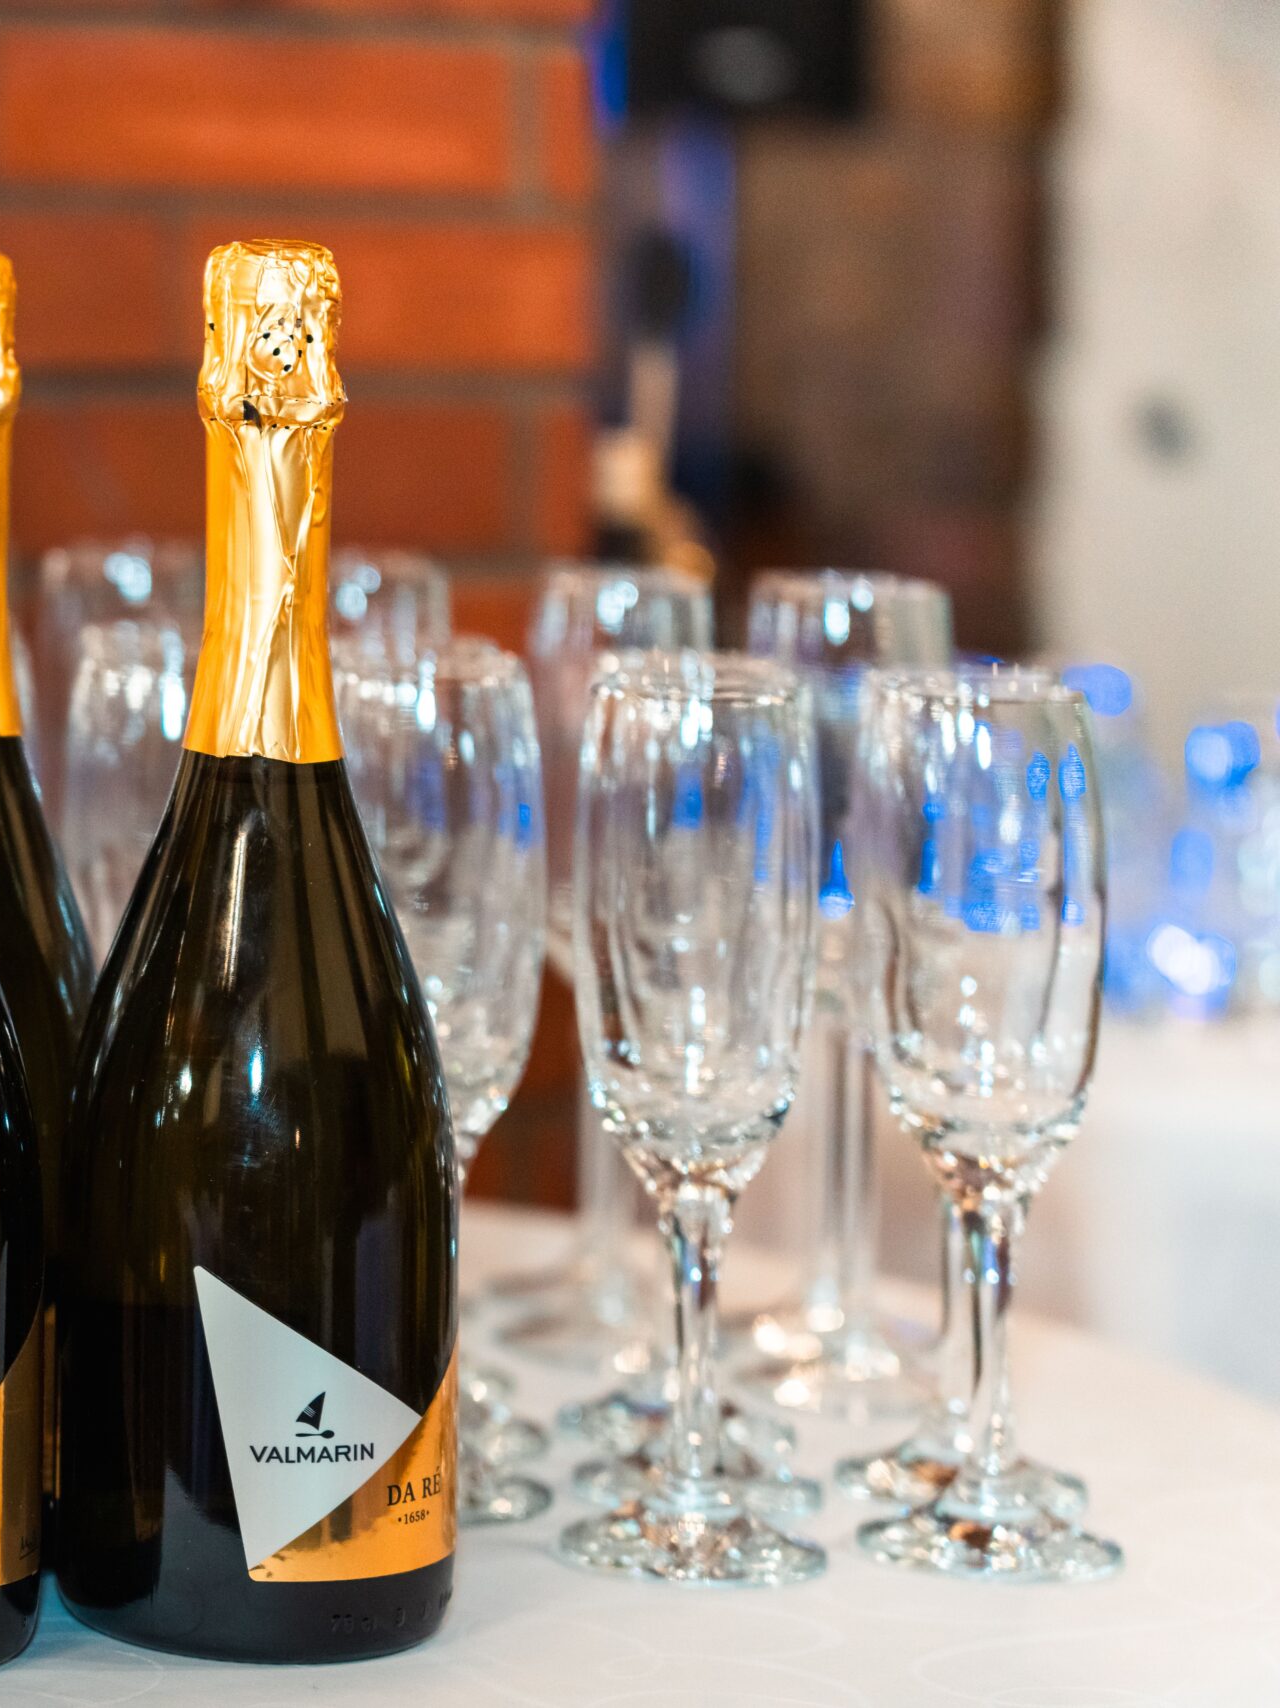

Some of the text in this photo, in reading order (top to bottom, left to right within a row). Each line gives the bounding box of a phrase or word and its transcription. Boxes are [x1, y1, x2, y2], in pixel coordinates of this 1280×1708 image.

[249, 1442, 375, 1463] VALMARIN
[387, 1465, 441, 1507] DA RÉ
